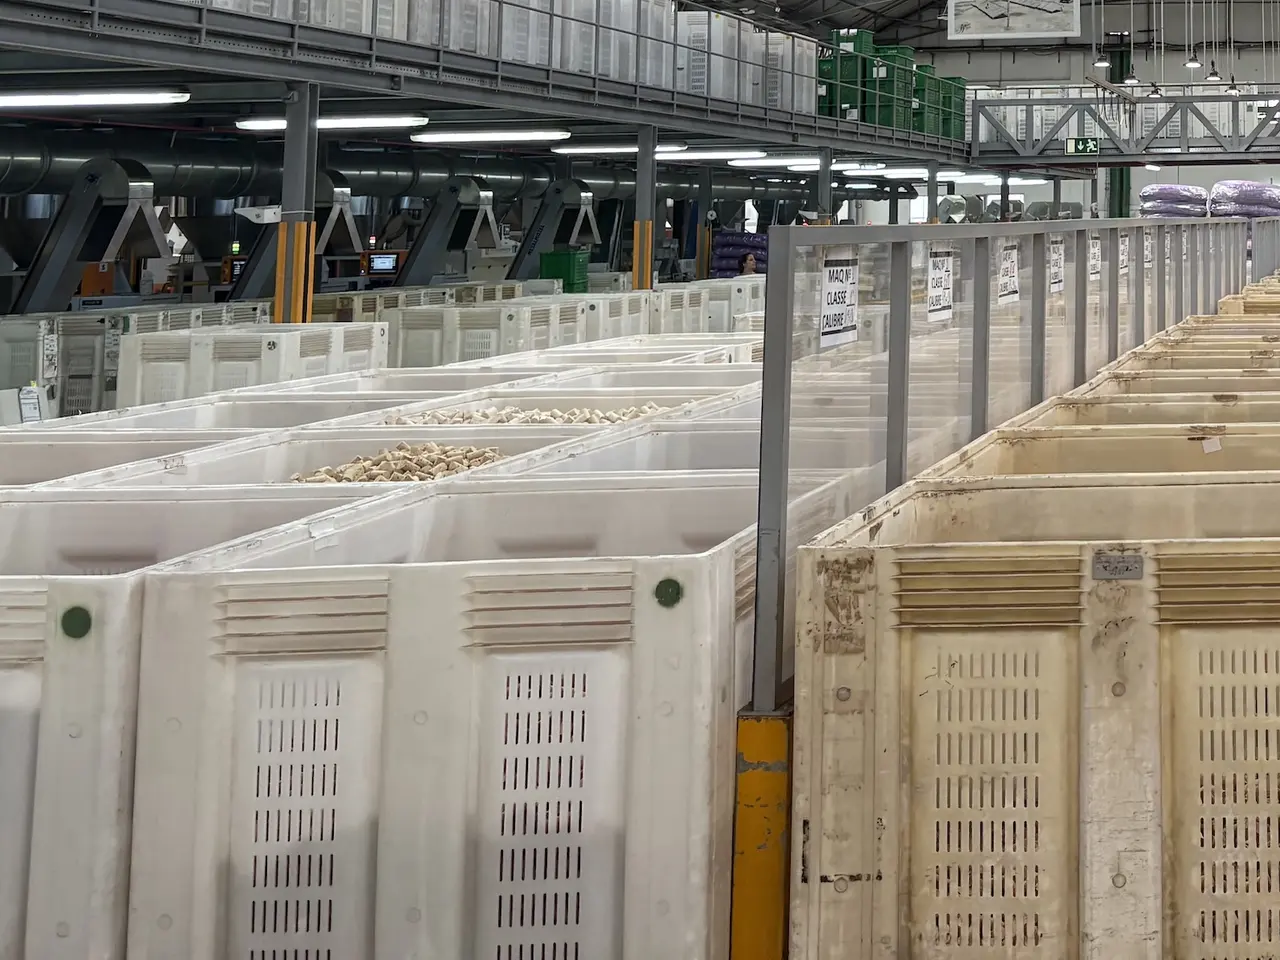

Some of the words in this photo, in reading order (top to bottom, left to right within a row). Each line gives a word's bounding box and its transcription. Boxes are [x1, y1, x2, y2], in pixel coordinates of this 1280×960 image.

[828, 268, 845, 284] MAQ
[826, 290, 847, 305] CLASSE
[822, 312, 845, 330] CALIBRE
